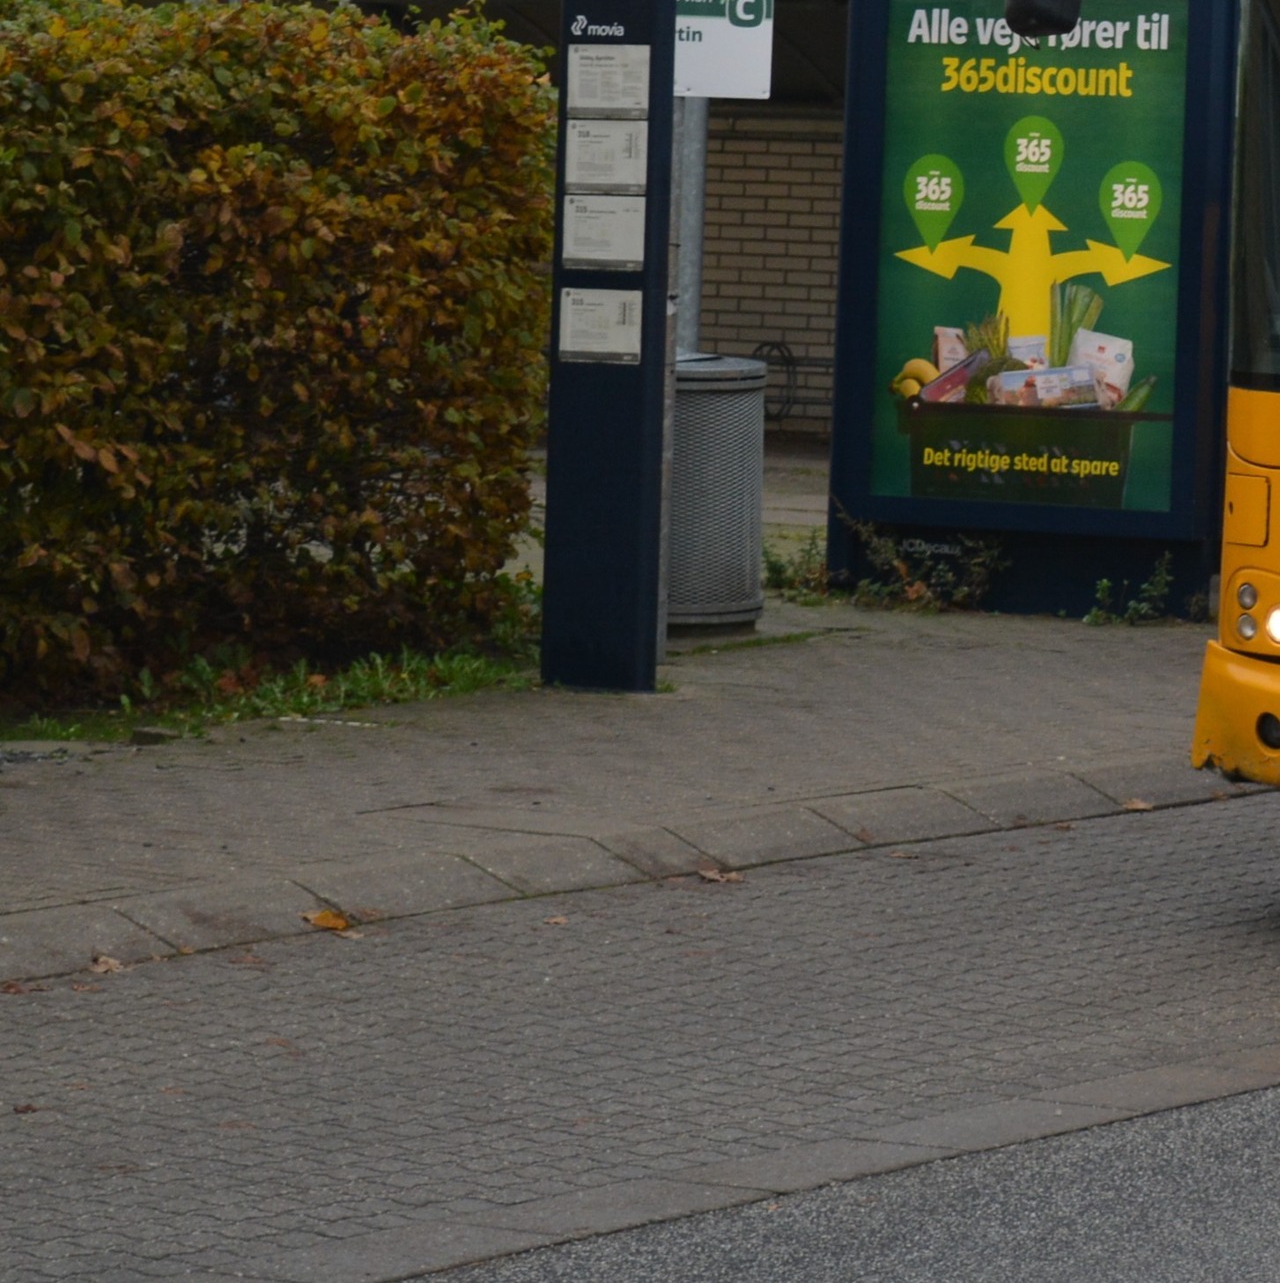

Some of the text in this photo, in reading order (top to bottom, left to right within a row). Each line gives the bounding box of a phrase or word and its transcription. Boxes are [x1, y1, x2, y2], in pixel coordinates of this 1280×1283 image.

[587, 21, 625, 37] movia
[907, 8, 969, 45] Alle
[1136, 12, 1170, 51] til
[941, 56, 1134, 98] 365discount
[1016, 138, 1052, 163] 365
[915, 176, 952, 202] 365
[1111, 183, 1150, 209] 365
[923, 447, 1120, 478] Det rigtige sted at spare
